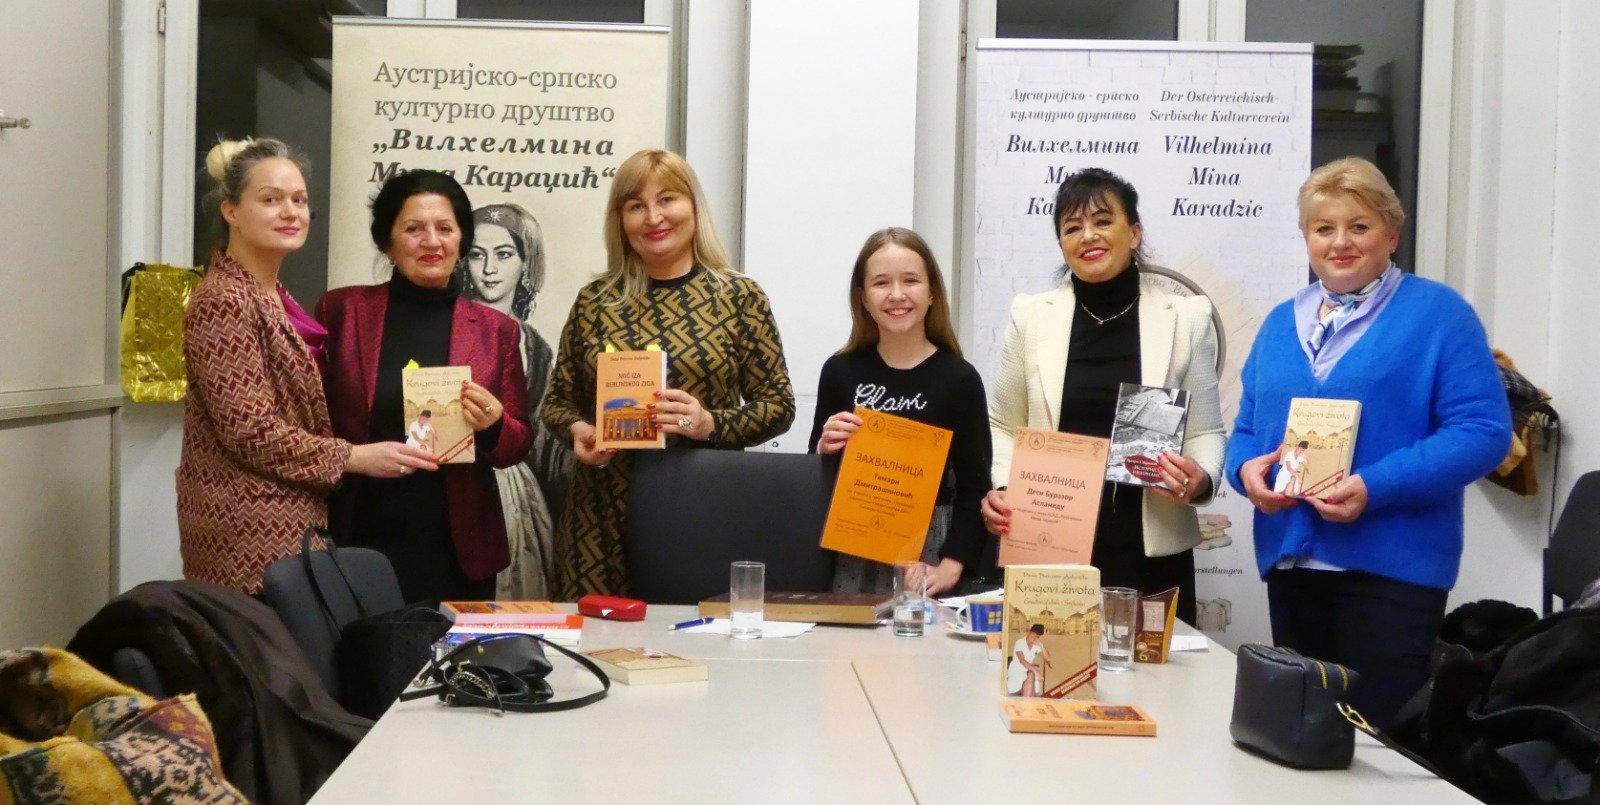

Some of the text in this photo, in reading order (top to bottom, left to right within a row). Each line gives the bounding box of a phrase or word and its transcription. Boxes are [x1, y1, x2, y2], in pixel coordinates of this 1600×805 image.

[373, 61, 618, 93] Аустријско-српско
[1009, 88, 1085, 104] Аустријско
[1096, 90, 1140, 104] српско
[1160, 90, 1184, 102] Der
[374, 100, 615, 126] културно друштво
[1010, 110, 1137, 124] културно друштво
[1149, 109, 1291, 123] Serbische Kulturverein
[372, 128, 614, 156] „Вилхелмина
[1005, 134, 1140, 155] Вилхелмина
[1163, 135, 1273, 156] Vilhelmina
[462, 164, 617, 194] Караџић“
[1188, 166, 1242, 186] Mina
[1170, 197, 1263, 218] Karadzic
[856, 452, 925, 478] ЗАХВАЛНИЦА
[1019, 470, 1087, 490] ЗАХВАЛНИЦА
[1014, 579, 1096, 598] Krugovi života
